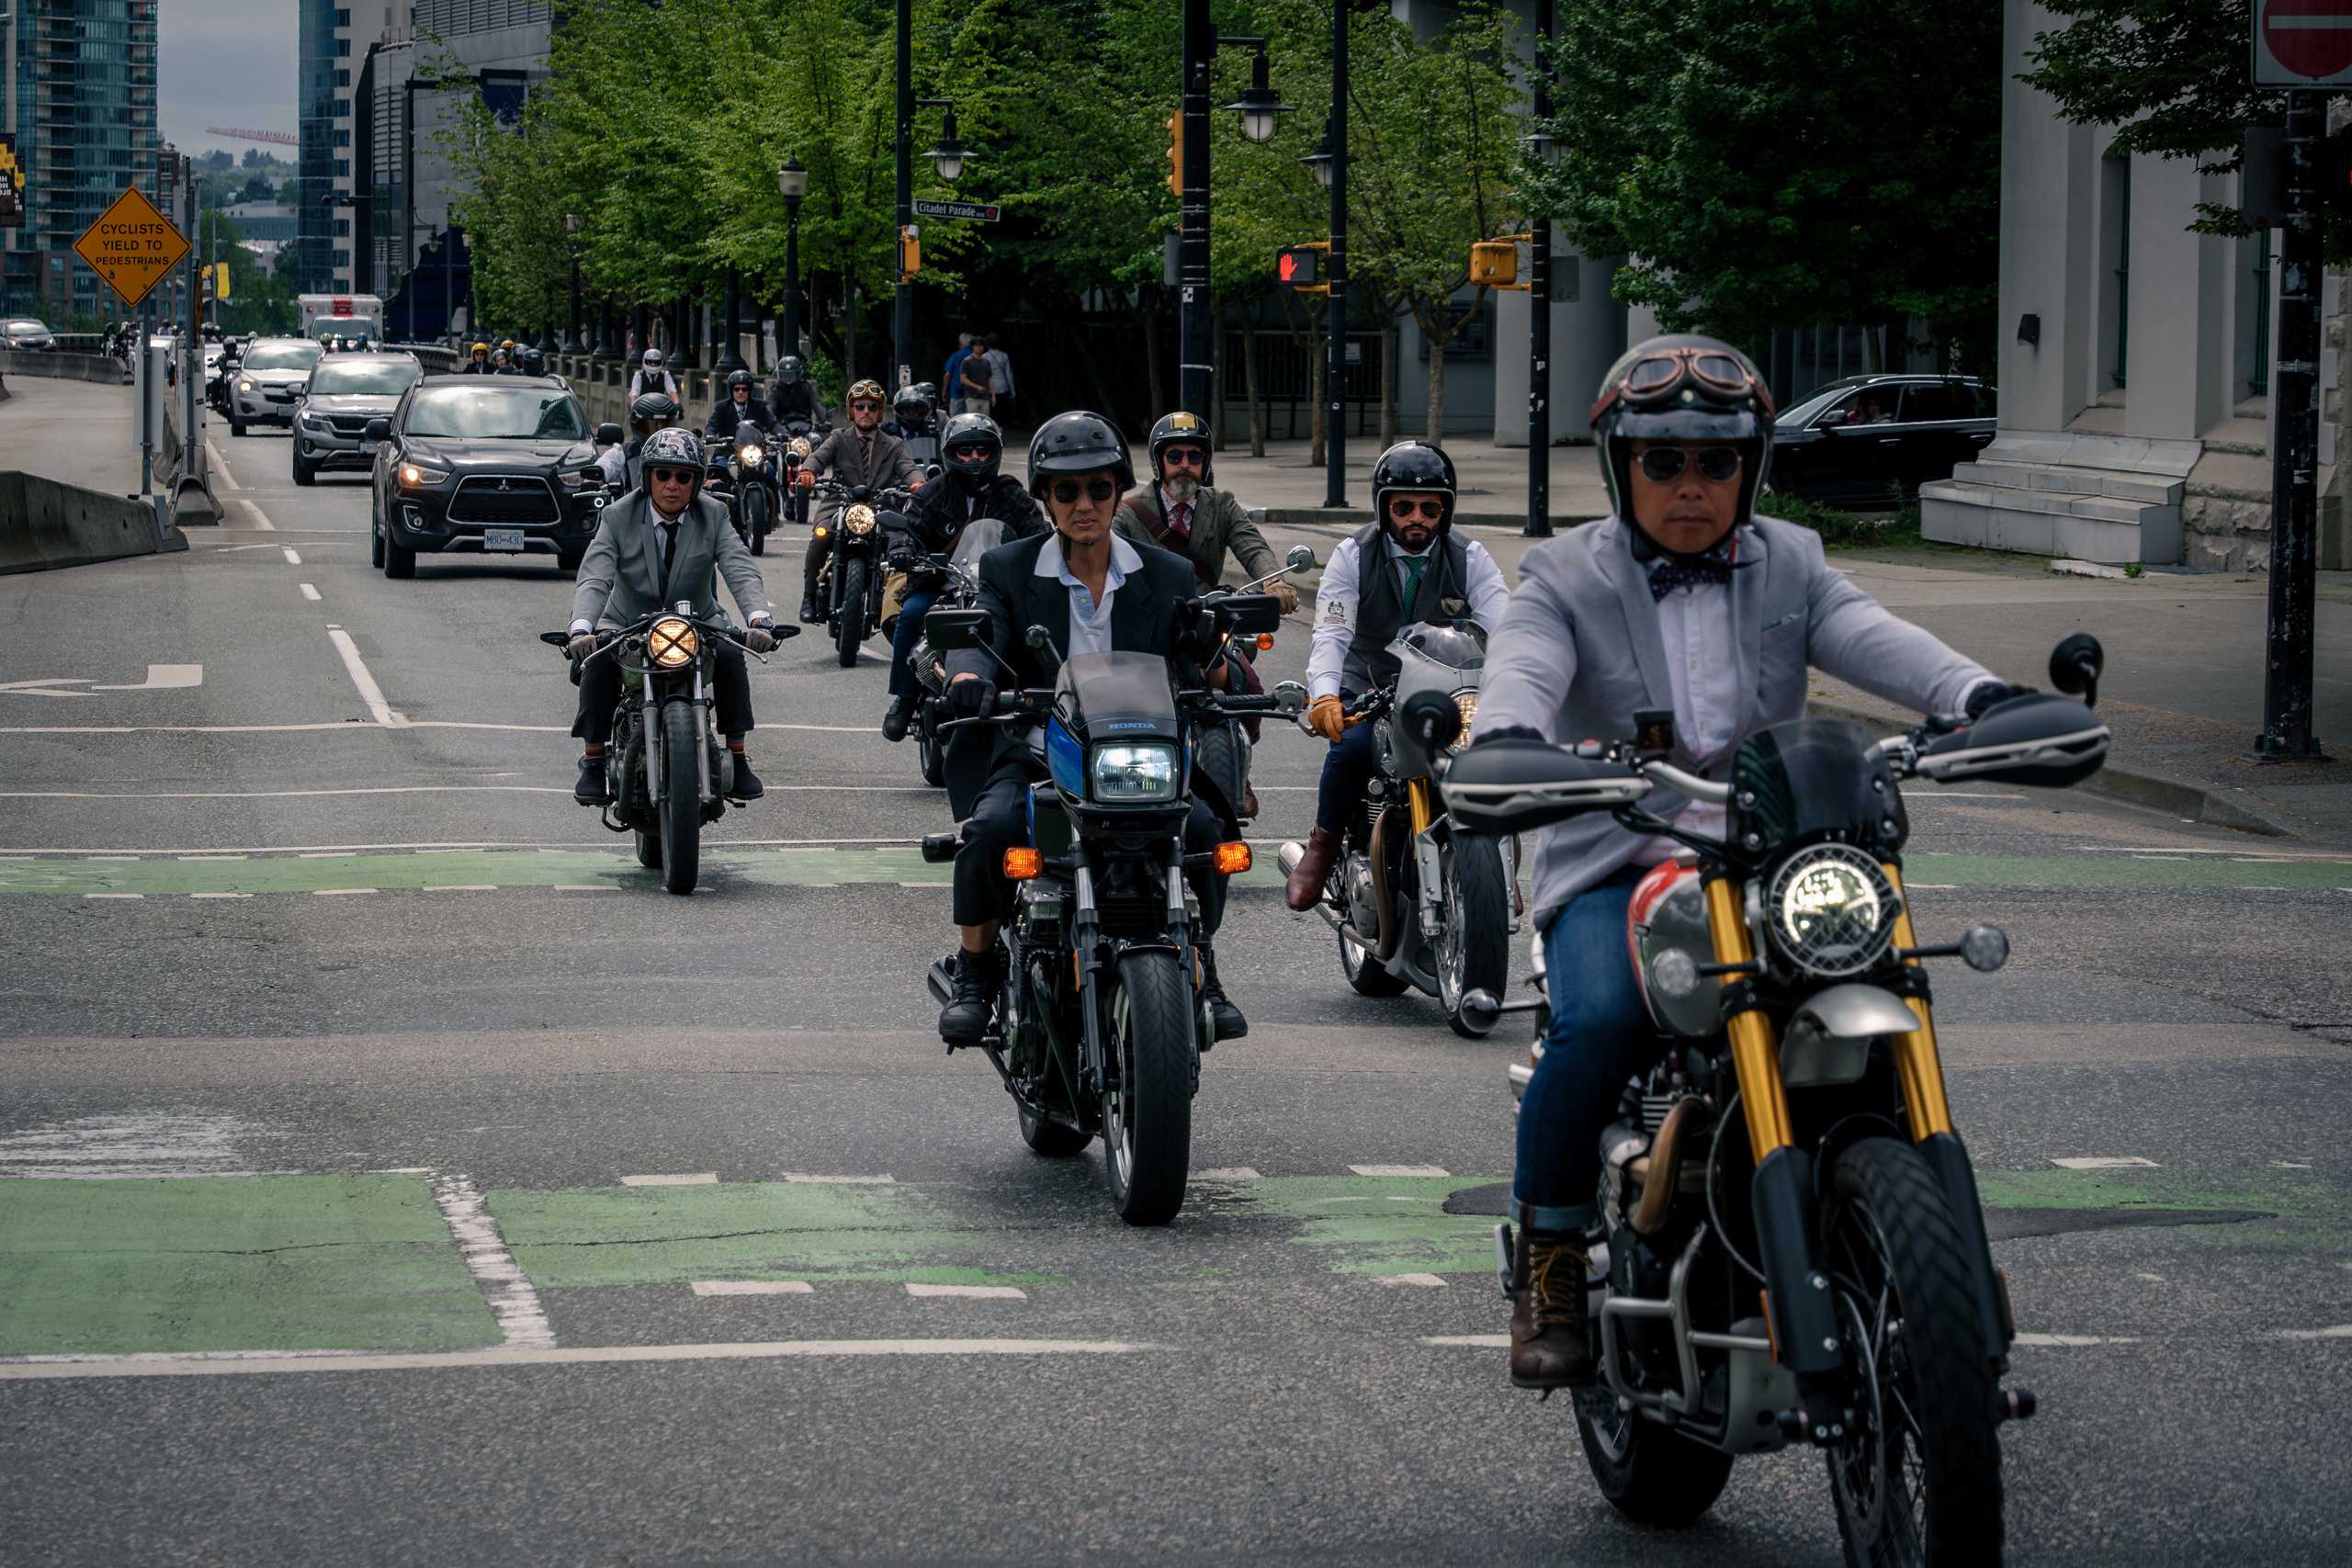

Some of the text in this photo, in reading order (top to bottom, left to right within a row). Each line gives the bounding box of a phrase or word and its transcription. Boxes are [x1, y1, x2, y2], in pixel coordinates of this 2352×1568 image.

[919, 203, 946, 214] Citadel
[949, 206, 976, 217] Parade
[101, 224, 164, 234] CYCLISTS
[102, 240, 163, 250] YIELD TO
[96, 256, 169, 265] PEDESTRIANS
